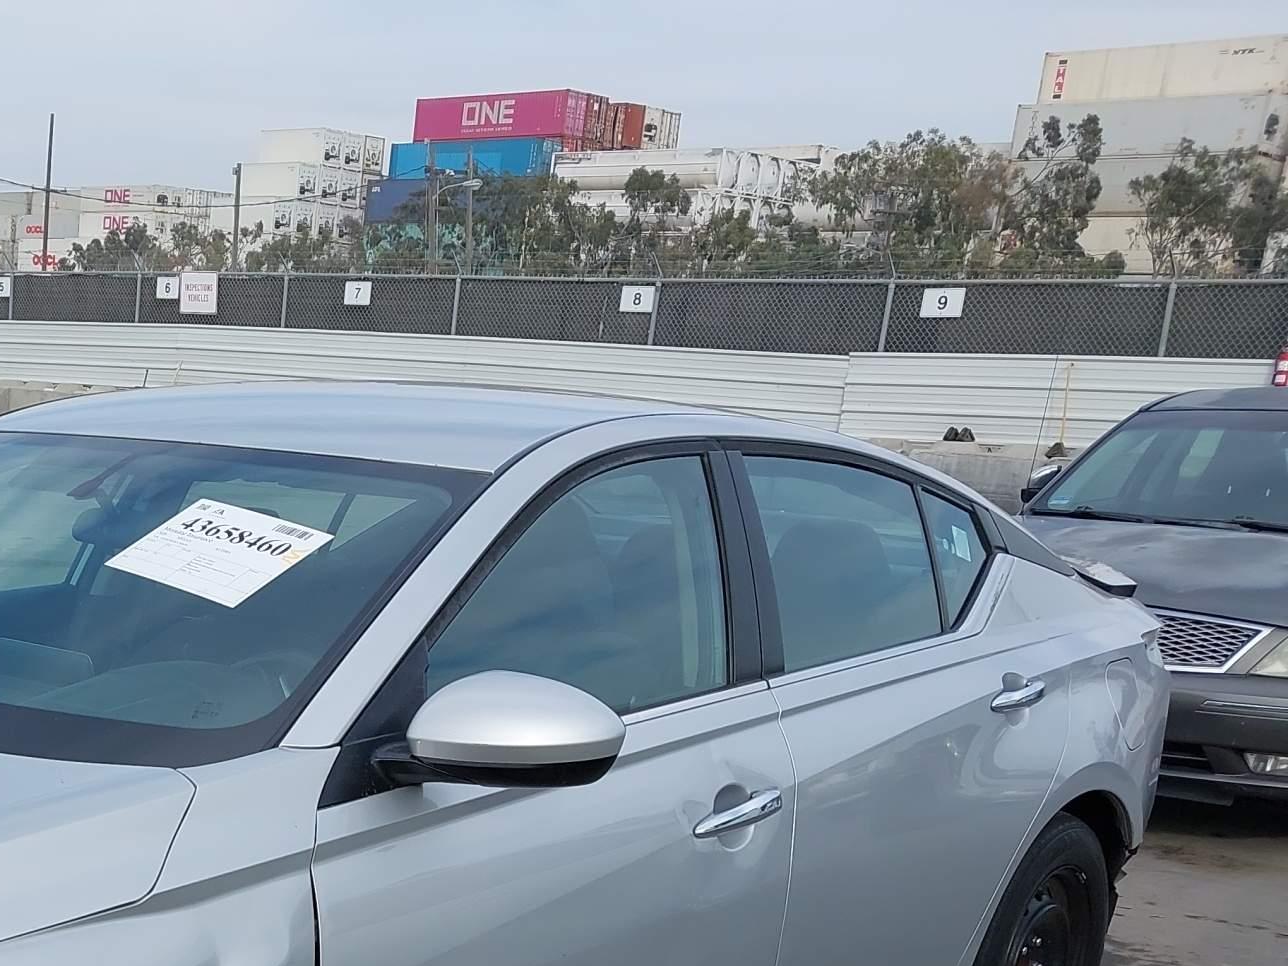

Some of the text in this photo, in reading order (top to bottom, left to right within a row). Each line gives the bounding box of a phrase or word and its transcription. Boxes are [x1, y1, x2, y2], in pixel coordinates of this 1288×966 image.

[462, 100, 515, 125] ONE
[104, 189, 130, 203] ONE
[103, 216, 130, 230] ONE
[0, 281, 5, 292] 5
[164, 282, 171, 293] 6
[355, 287, 362, 299] 7
[633, 292, 642, 306] 8
[937, 295, 948, 310] 9
[181, 517, 292, 556] 43658460
